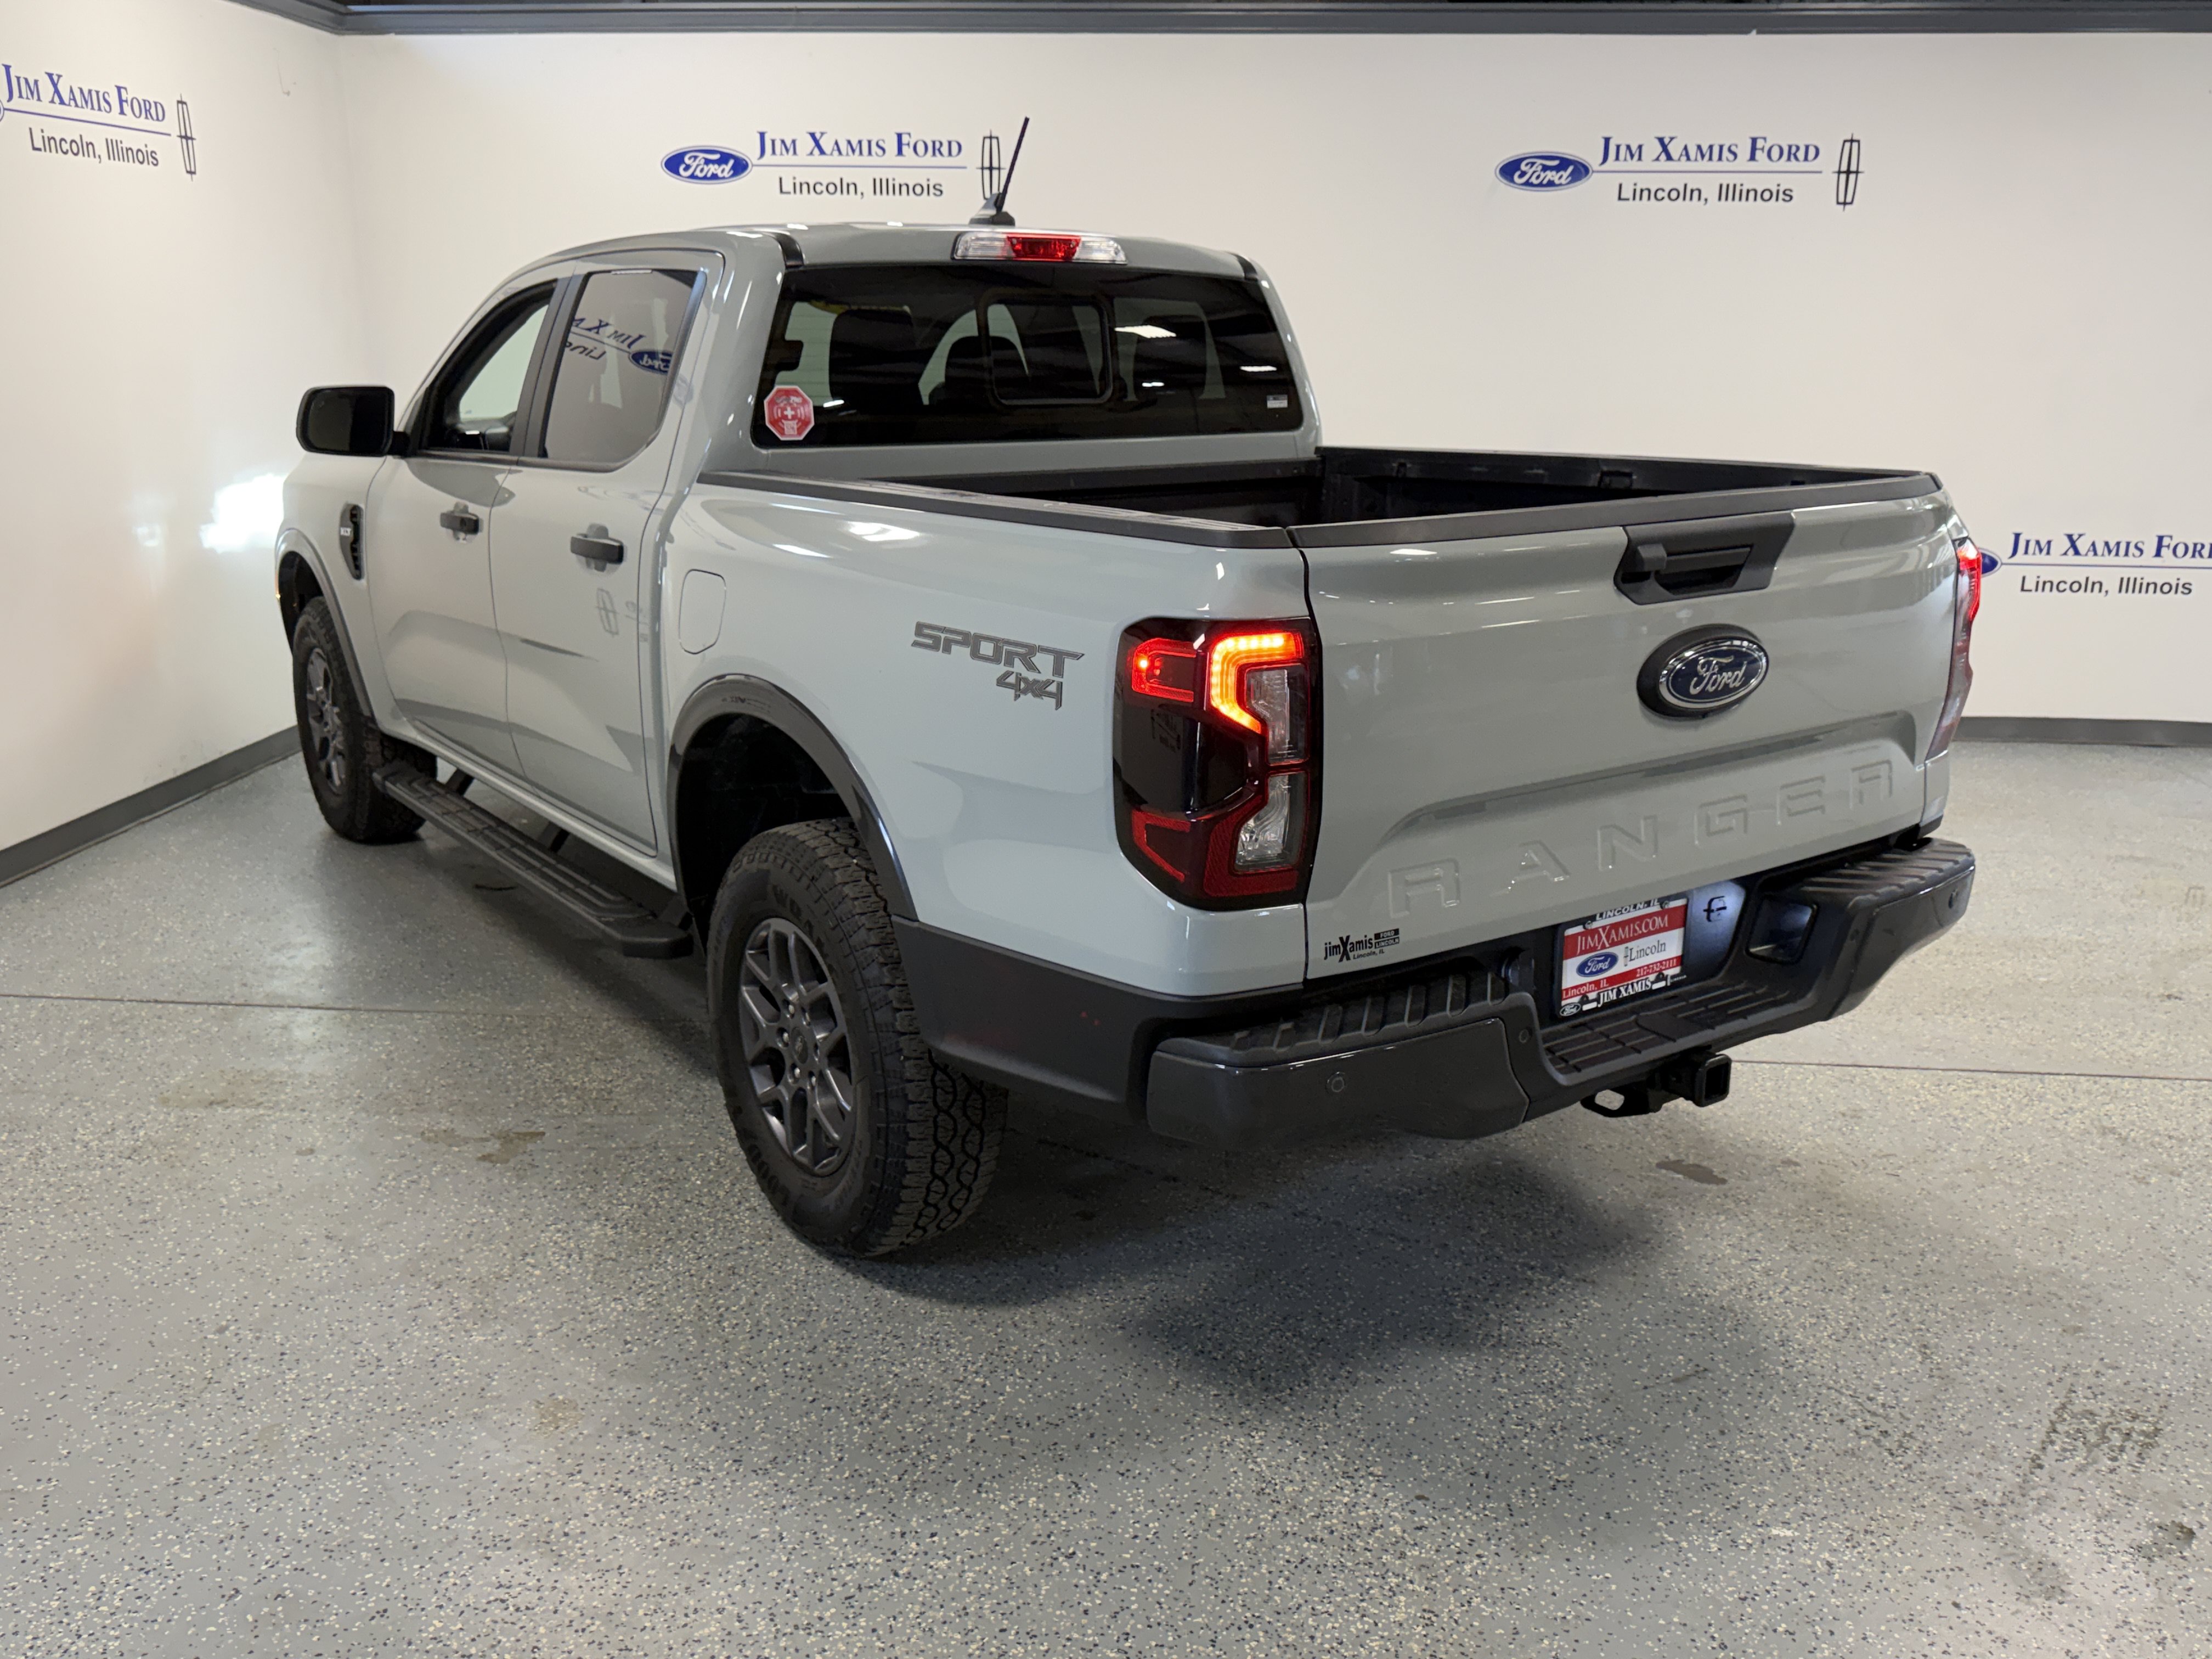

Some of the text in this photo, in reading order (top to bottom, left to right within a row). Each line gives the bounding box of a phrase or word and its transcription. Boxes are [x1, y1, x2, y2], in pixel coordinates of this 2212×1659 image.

[2, 64, 165, 122] JIM XAMIS FORD
[29, 127, 159, 167] Lincoln, Illinois
[757, 131, 962, 160] JIM XAMIS FORD
[1599, 137, 1820, 166] JIM XAMIS FORD
[679, 152, 734, 178] Ford
[1513, 158, 1574, 185] Ford
[778, 177, 943, 199] Lincoln, Illinois
[1617, 183, 1794, 205] Lincoln, Illinois
[2008, 532, 2053, 559] JIM
[2060, 533, 2145, 558] XAMIS
[2021, 575, 2193, 597] Lincoln, Illinois
[911, 621, 1085, 678] SPORT
[1690, 656, 1747, 695] Ford
[1387, 759, 1893, 919] RANGER
[1584, 940, 1666, 974] Ford Lincoln
[1598, 978, 1652, 1008] JIM XAMIS
[1600, 979, 1609, 988] IL
